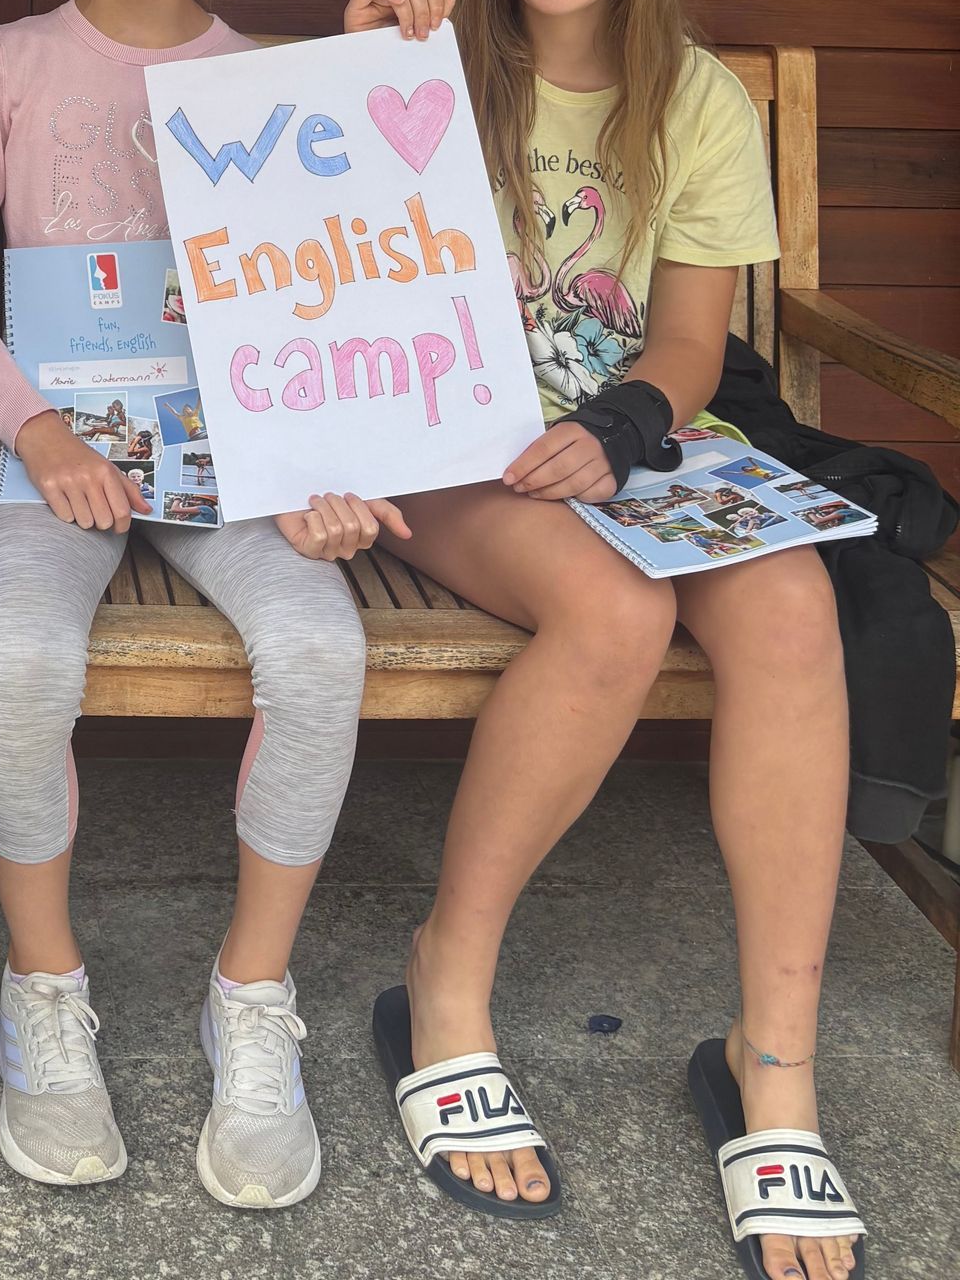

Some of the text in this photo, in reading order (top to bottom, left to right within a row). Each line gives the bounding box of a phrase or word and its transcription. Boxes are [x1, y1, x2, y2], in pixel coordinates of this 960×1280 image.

[166, 103, 351, 187] We
[528, 148, 560, 174] the
[41, 191, 82, 234] Las
[182, 192, 476, 320] English
[93, 292, 120, 301] FOKUS
[50, 376, 77, 385] Marie
[229, 295, 493, 427] camp!
[436, 1084, 526, 1125] FILA
[756, 1164, 845, 1202] FILA
